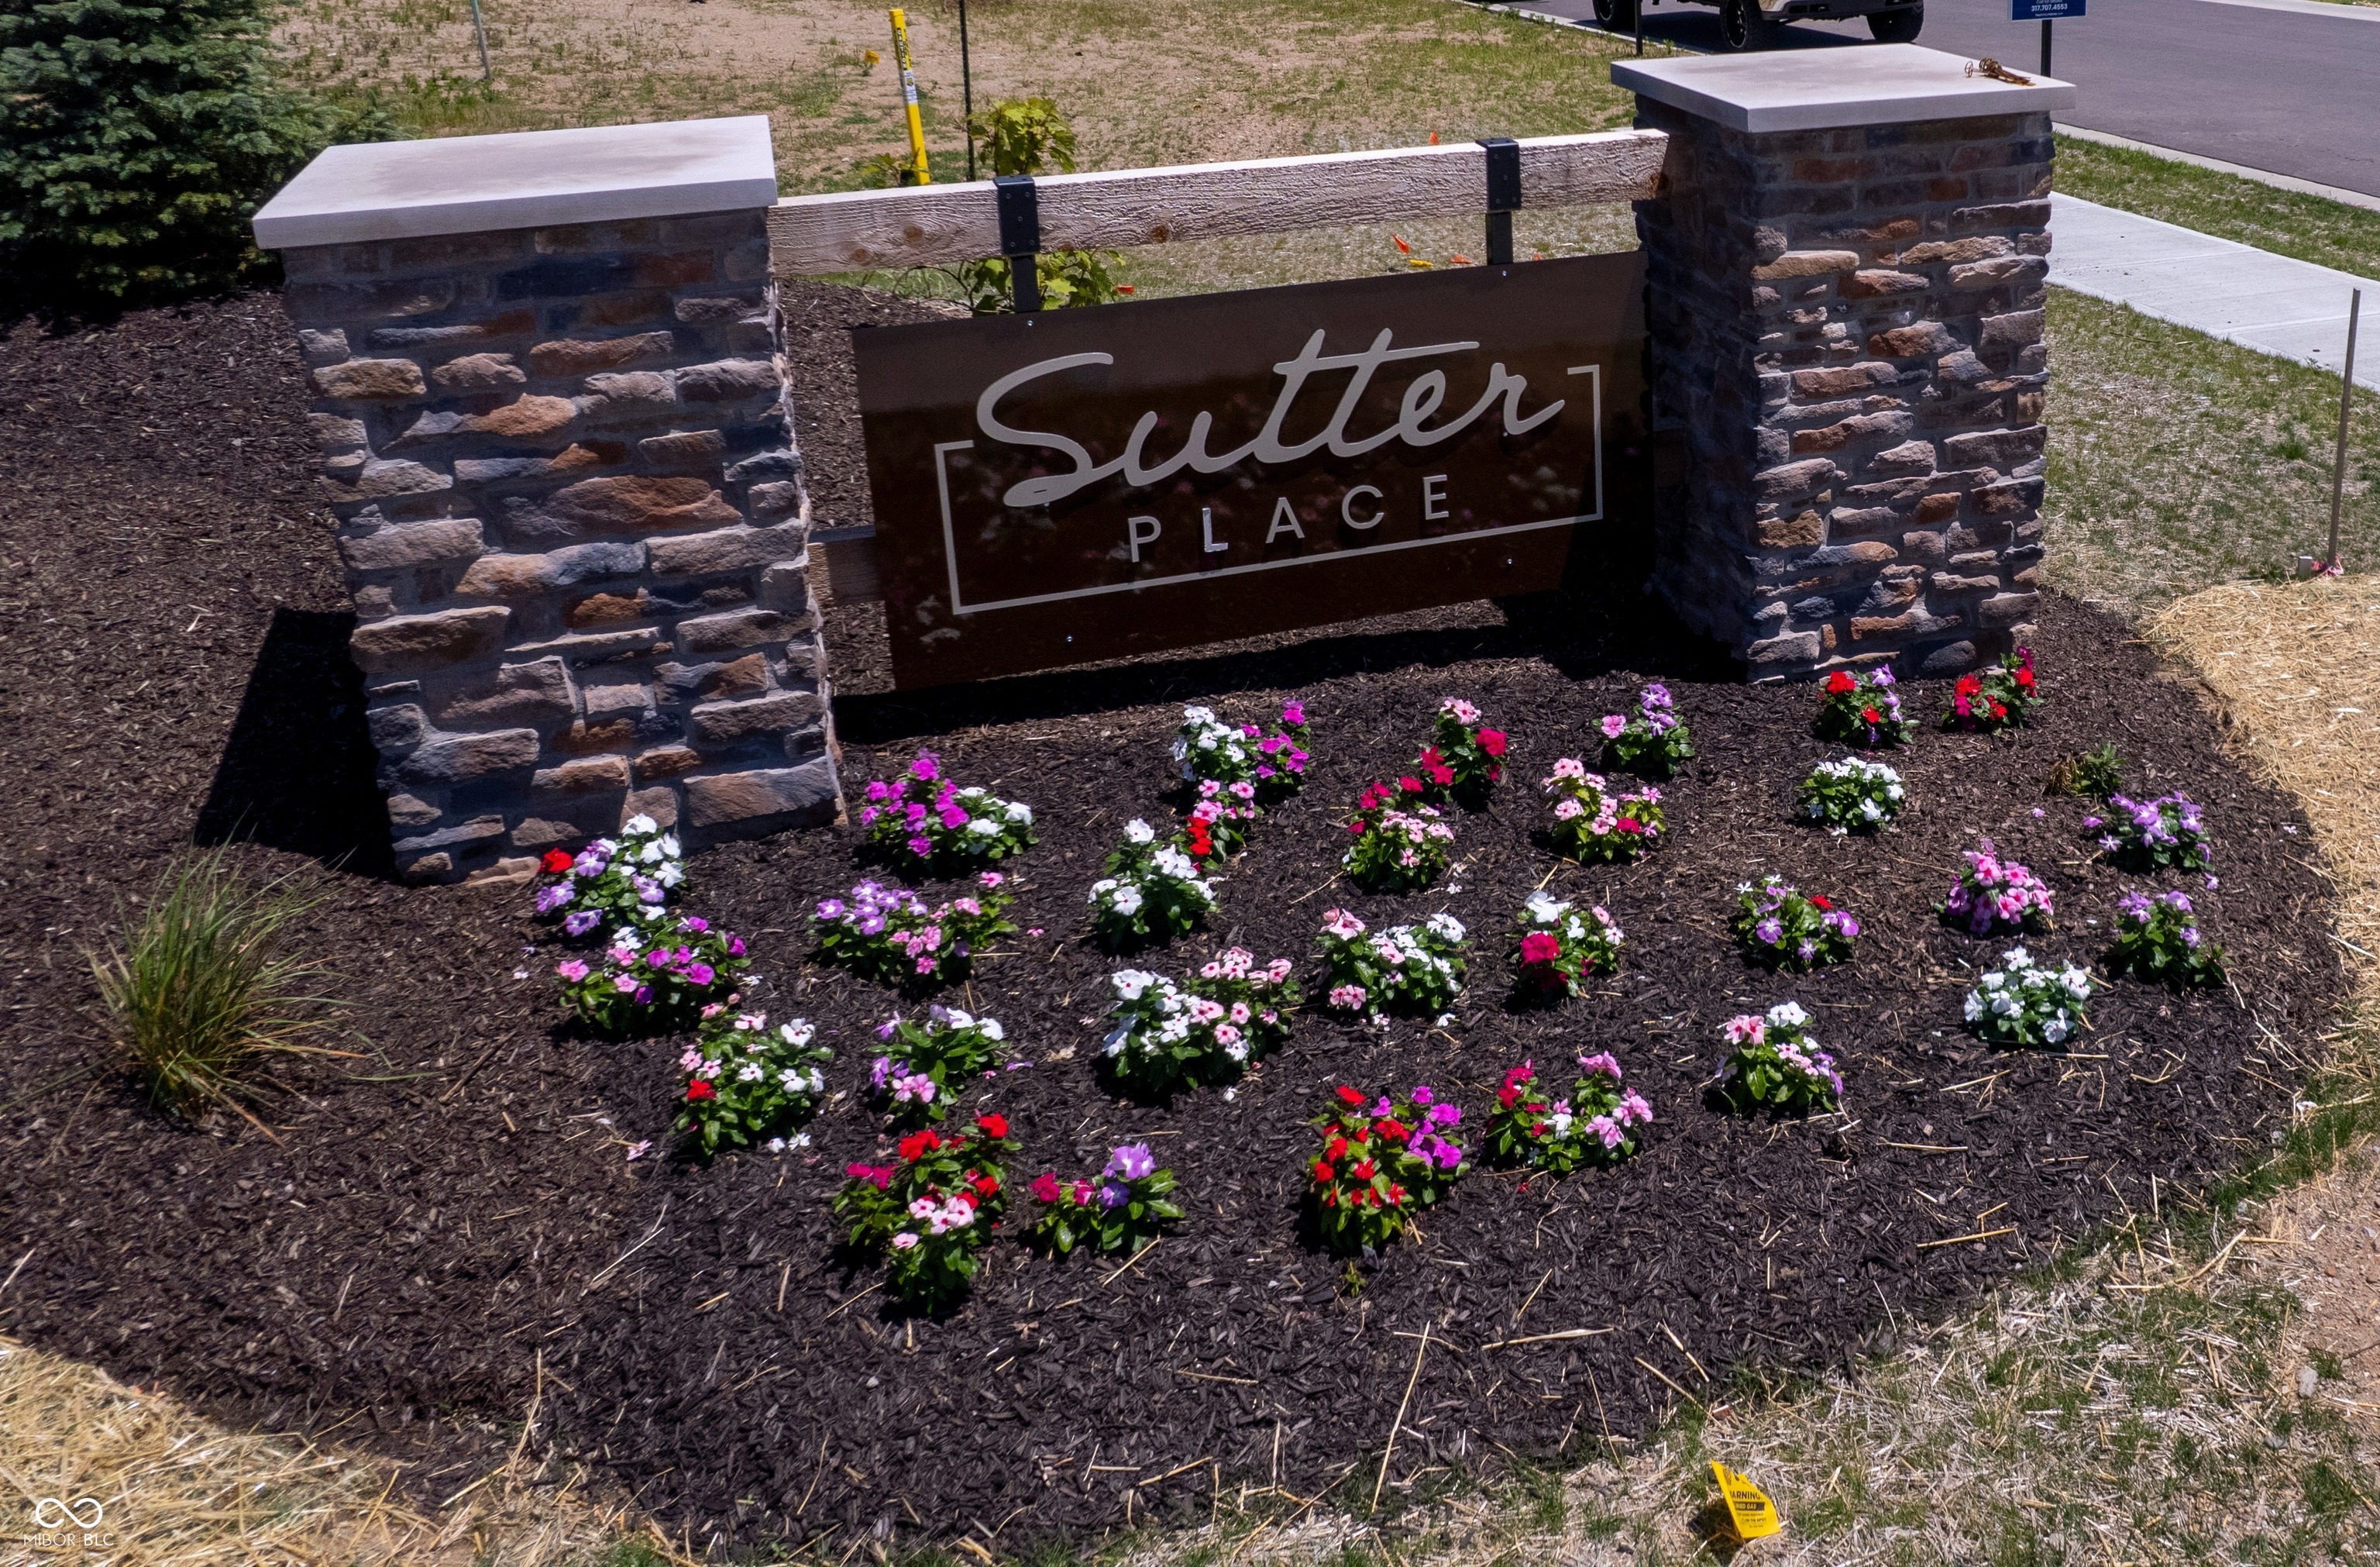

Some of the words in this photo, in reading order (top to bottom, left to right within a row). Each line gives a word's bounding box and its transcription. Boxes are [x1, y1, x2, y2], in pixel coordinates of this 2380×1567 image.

[2031, 3, 2068, 12] 317.707.4553
[897, 29, 907, 68] CAUTION
[976, 327, 1565, 508] Sutter
[1128, 474, 1450, 563] PLACE
